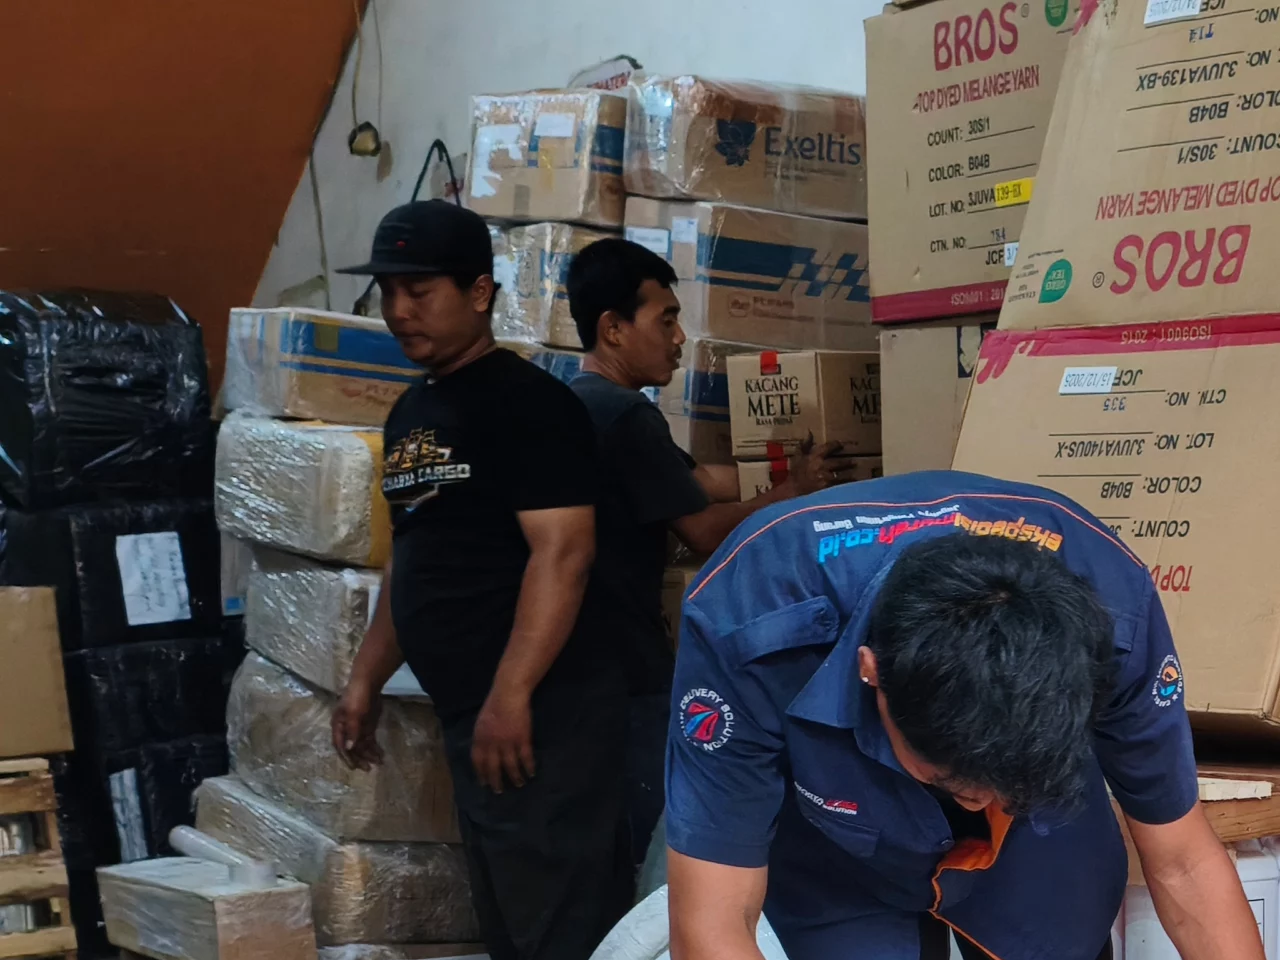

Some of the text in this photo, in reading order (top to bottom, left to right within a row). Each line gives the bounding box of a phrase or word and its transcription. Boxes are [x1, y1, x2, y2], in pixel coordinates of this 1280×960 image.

[1255, 6, 1280, 23] NO:
[934, 2, 1018, 71] BROS
[1246, 50, 1271, 66] NO:
[1136, 61, 1238, 91] 3JUVA139-BX
[918, 64, 1040, 113] TOP DYED MELANGE YARN
[1189, 101, 1229, 123] B04B
[927, 117, 990, 146] COUNT: 30S/1
[765, 127, 861, 165] Exeltis
[1176, 143, 1217, 164] 30S/1
[928, 164, 964, 182] COLOR:
[1136, 183, 1214, 215] MELANGE
[1217, 178, 1259, 207] DYED
[951, 199, 965, 214] NO:
[1095, 191, 1136, 221] YARN
[953, 236, 967, 250] NO:
[985, 250, 1004, 266] JCF
[1110, 224, 1251, 294] BROS
[1121, 329, 1149, 346] 2015
[1159, 325, 1212, 343] ISO9001
[745, 376, 799, 393] KACANG
[1112, 369, 1143, 386] JCF
[748, 393, 800, 417] METE
[1165, 391, 1190, 407] NO:
[1199, 389, 1227, 405] CTN.
[1055, 433, 1215, 458] LOT. NO: 3JUVA140US-X
[1101, 476, 1202, 499] COLOR: B04B
[813, 520, 854, 533] Barang
[1131, 520, 1190, 538] COUNT:
[1160, 565, 1193, 592] TOP
[703, 704, 735, 751] SOLUTION
